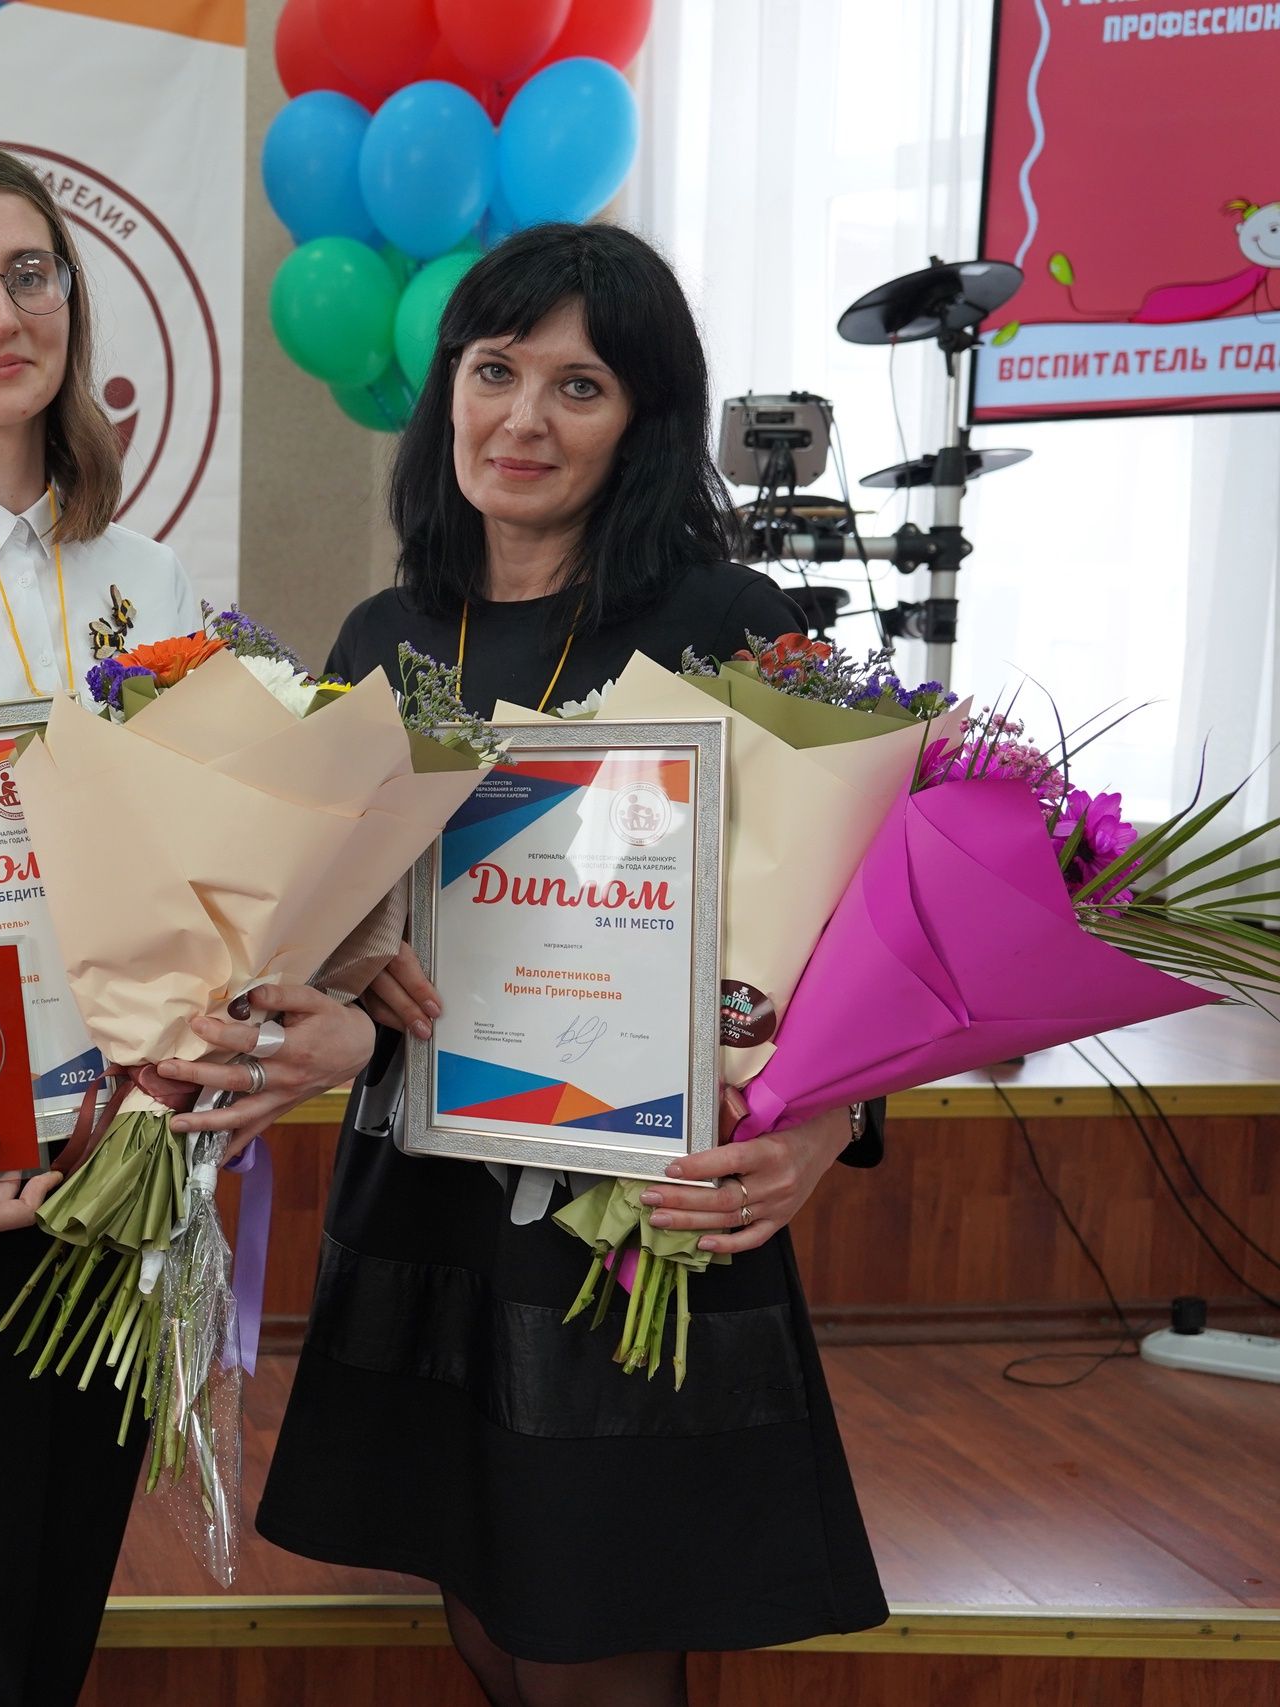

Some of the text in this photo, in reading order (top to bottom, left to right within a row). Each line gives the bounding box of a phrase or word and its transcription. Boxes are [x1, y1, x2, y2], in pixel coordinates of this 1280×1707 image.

[1103, 3, 1280, 43] ПРОФЕССИОН
[998, 343, 1280, 382] ВОСПИТАТЕЛЬ ГОД
[469, 862, 676, 911] Диплом
[595, 917, 675, 931] ЗА III МЕСТО
[544, 942, 583, 950] награждается
[515, 966, 611, 982] Малолетникова
[504, 982, 623, 1000] Ирина Григорьевна
[60, 1069, 96, 1086] 2022
[635, 1112, 673, 1128] 2022
